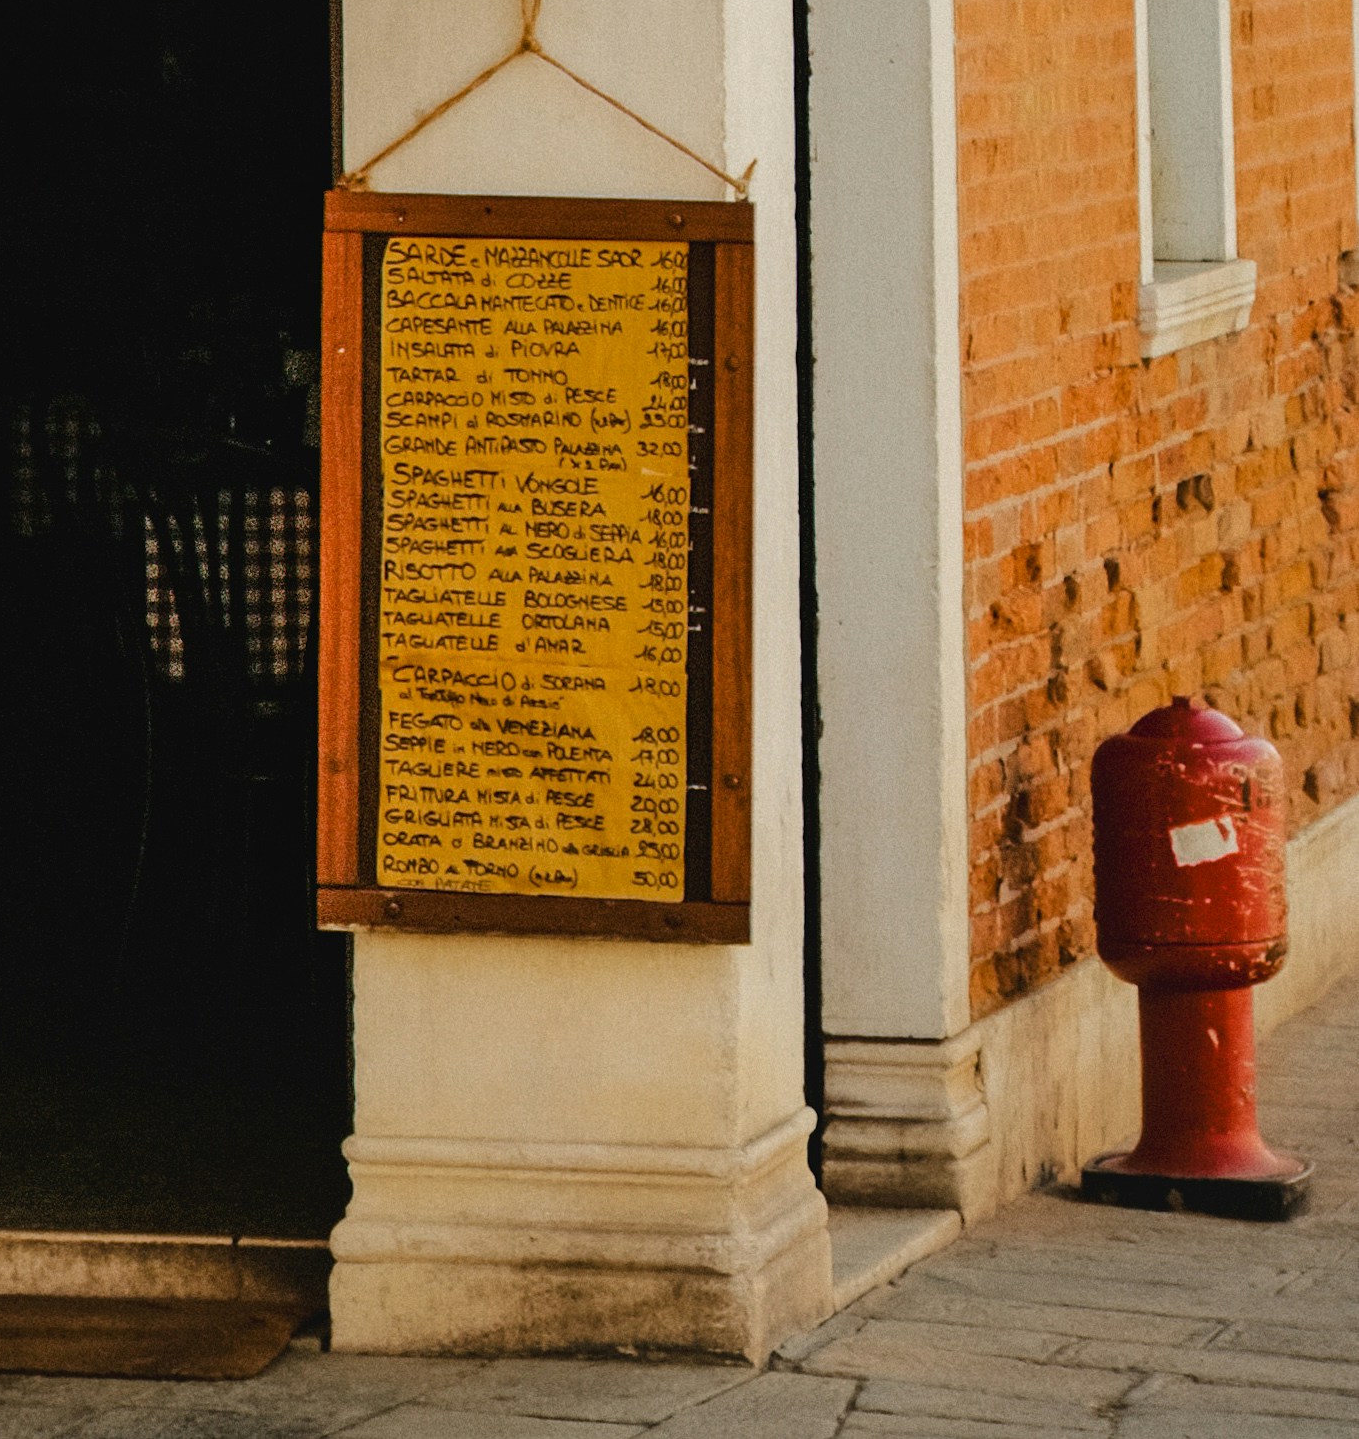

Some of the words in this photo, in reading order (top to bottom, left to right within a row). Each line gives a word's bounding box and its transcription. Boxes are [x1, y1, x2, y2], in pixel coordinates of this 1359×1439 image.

[386, 242, 466, 267] SARDE
[597, 249, 643, 268] SAOR
[387, 267, 474, 285] SALTATA
[481, 294, 575, 312] MANTECATO
[386, 317, 491, 335] CAPESANTE
[505, 320, 537, 335] ALLA
[390, 339, 475, 360] INSALATA
[386, 367, 460, 382] TARTAR
[504, 368, 568, 385] TONNO
[566, 387, 617, 405] PESCE
[384, 412, 457, 429] SCAMPI
[486, 411, 581, 427] ROSMARINO
[384, 435, 457, 456] GRANDE
[636, 441, 682, 457] 32,00
[391, 462, 505, 489] SPAGHETTI
[516, 472, 598, 494] VONGOLE
[640, 483, 687, 506] 16,00
[387, 489, 490, 510] SPAGHETTI
[532, 498, 606, 517] BUSERA
[639, 508, 683, 529] 18,00
[386, 513, 489, 534] SPAGHETTI
[525, 521, 569, 539] NERO
[649, 530, 686, 552] 16,00
[385, 537, 485, 555] SPAGHETTI
[644, 552, 685, 571] 18,00
[384, 559, 477, 581] RISOTTO
[489, 568, 523, 583] ALLA
[524, 590, 627, 611] BOLOGNESE
[522, 613, 610, 631] ORTOLANA
[637, 620, 684, 641] 15,00
[635, 645, 682, 665] 16,00
[393, 665, 516, 691] CARPACCIO
[541, 674, 606, 690] SORANA
[629, 676, 681, 698] 18,00
[389, 712, 463, 730] FEGATO
[496, 718, 596, 740] VENEZIANA
[633, 726, 680, 745] 18,00
[384, 734, 445, 753] SEPPIE
[472, 740, 520, 757] NERO
[547, 742, 613, 762] POLENTA
[631, 749, 679, 769] 17,00
[386, 784, 471, 804] FRITTURA
[546, 789, 595, 808] PESCE
[630, 795, 679, 819] 20,00
[556, 812, 604, 831] PESCE
[630, 818, 679, 837] 28,00
[383, 831, 441, 847] ORATA
[473, 833, 558, 853] BRANZINO
[383, 854, 439, 875] ROMBO
[632, 871, 678, 890] 50,00
